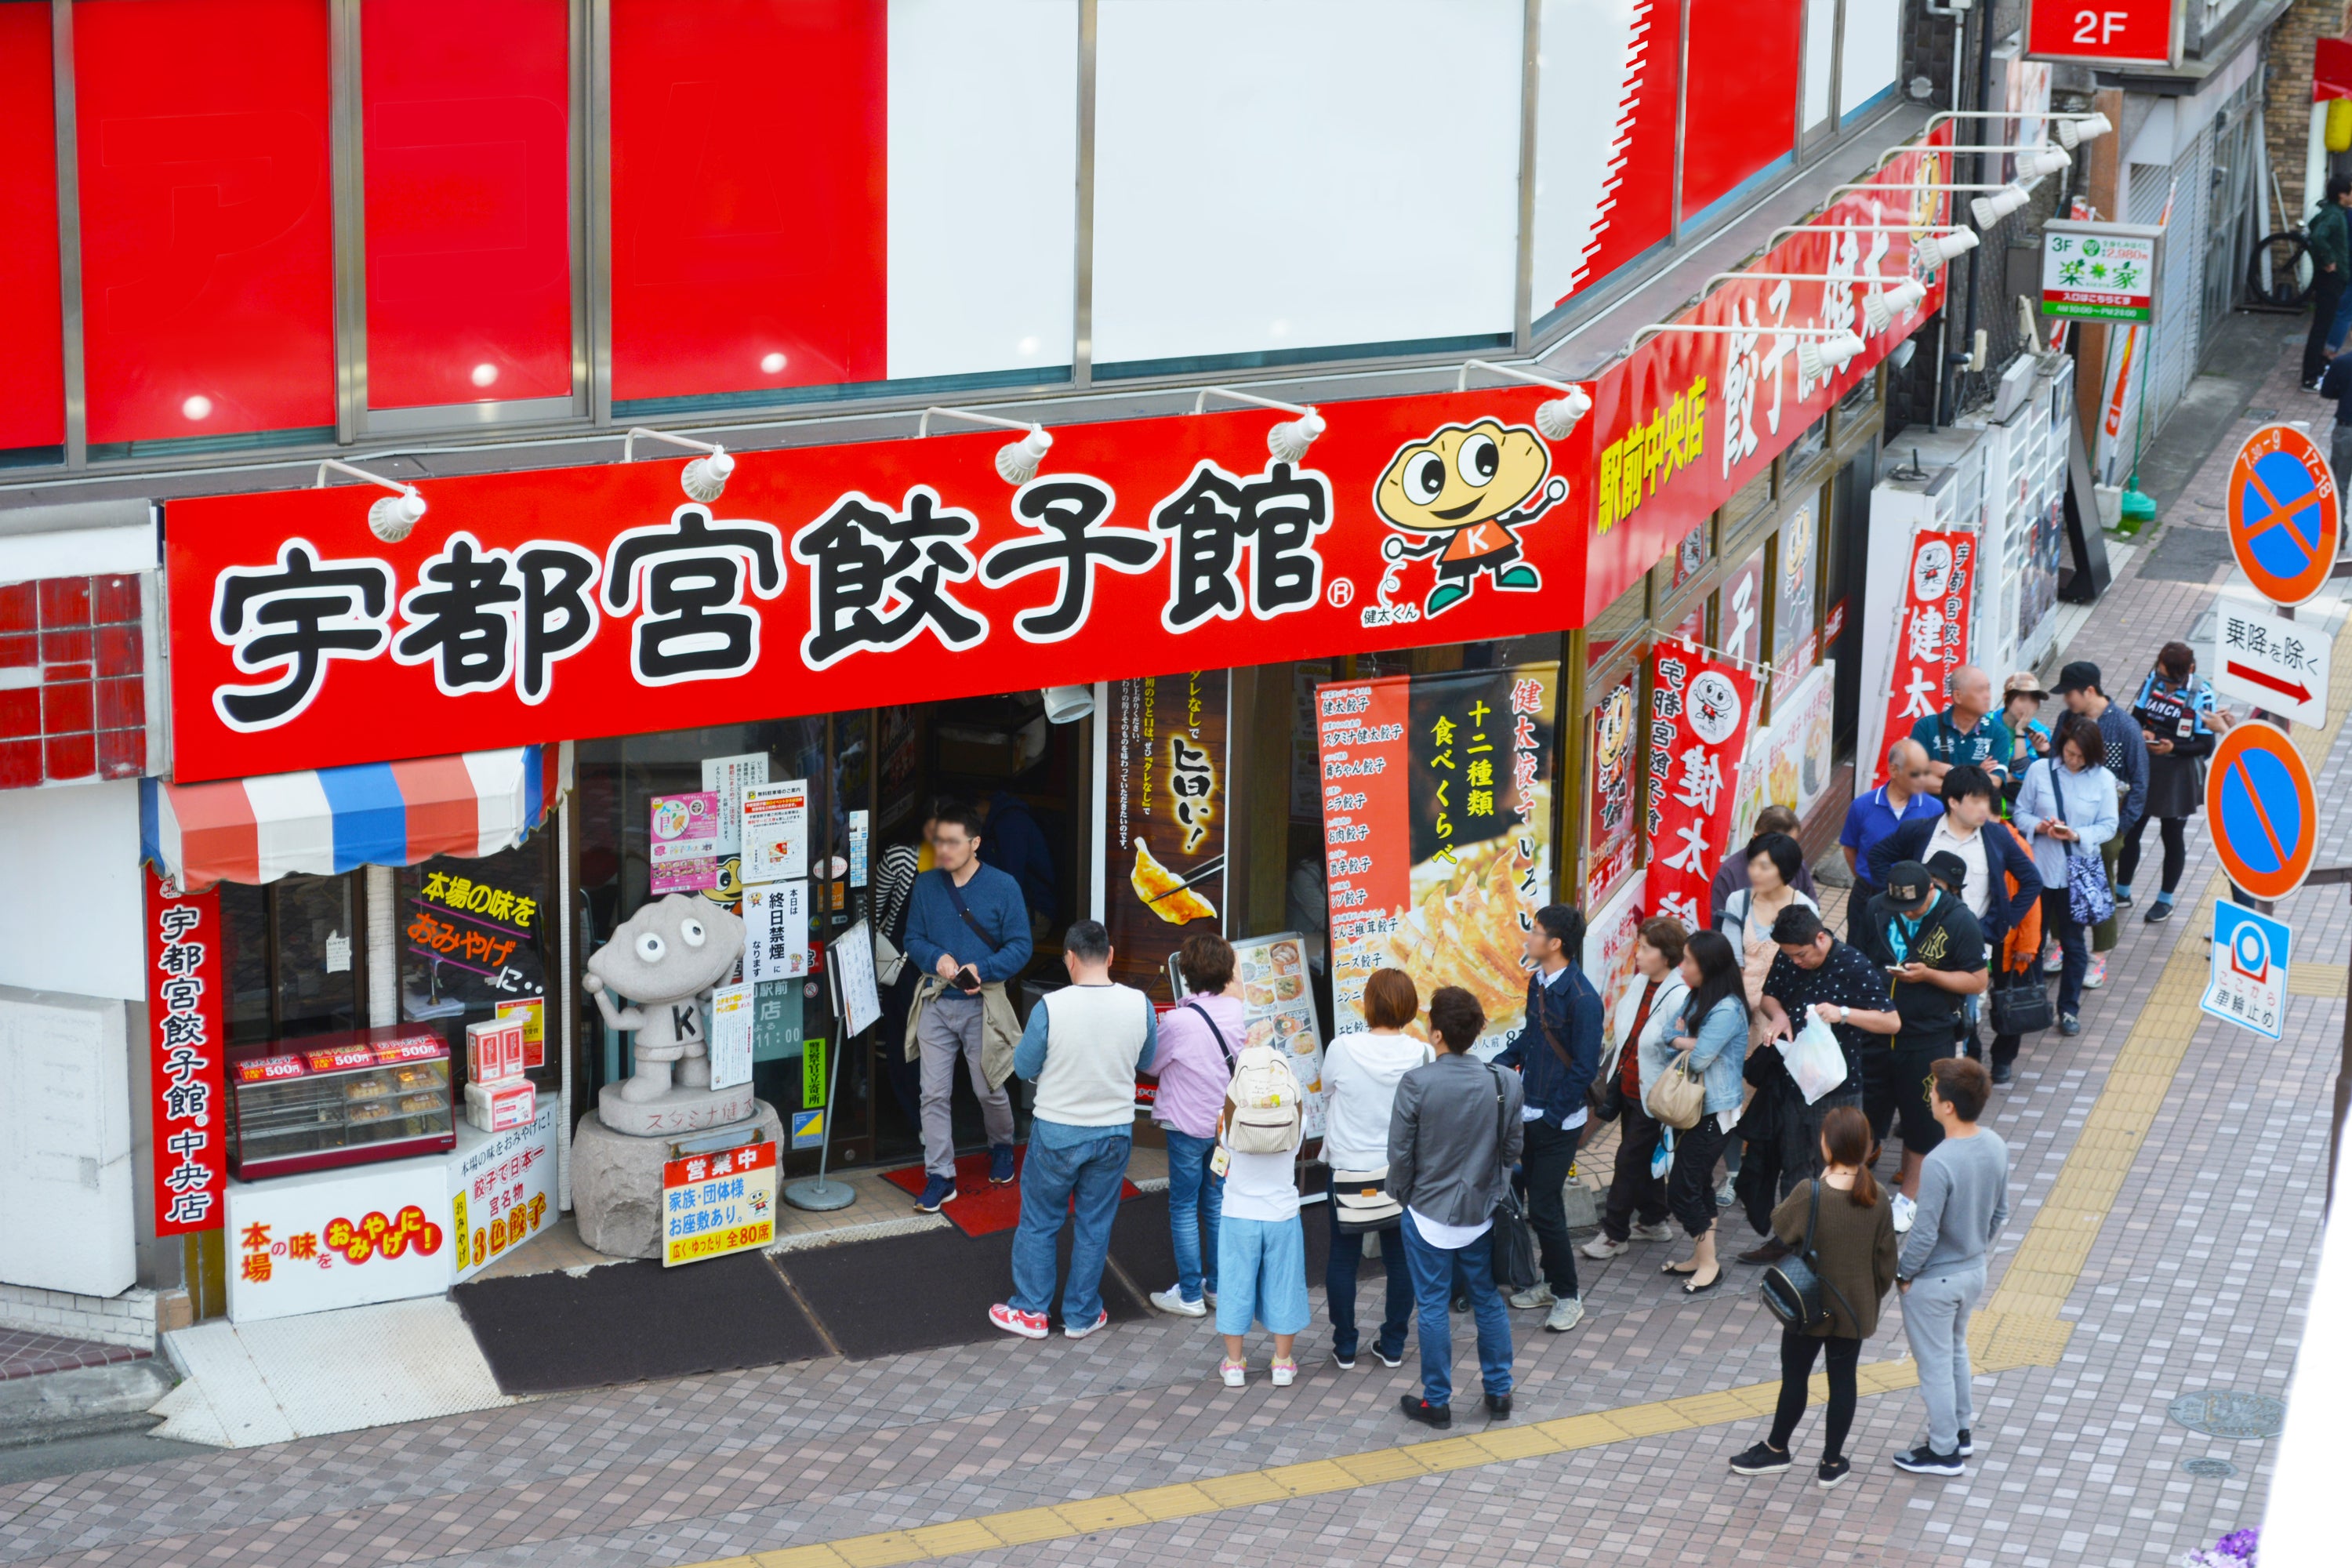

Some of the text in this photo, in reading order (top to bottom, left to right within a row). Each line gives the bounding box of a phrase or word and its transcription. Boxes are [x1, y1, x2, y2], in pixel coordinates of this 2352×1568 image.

[2072, 11, 2127, 45] 2F
[2052, 237, 2074, 252] 3F
[1598, 376, 1707, 535] 駅前中央店
[2301, 445, 2333, 499] 17-18
[1467, 525, 1489, 554] K
[211, 458, 1334, 733] 宇都宮餃子館
[1363, 604, 1418, 626] 健太くん
[1897, 604, 1945, 720] 健太
[2226, 617, 2320, 677] 乗降を除く
[1323, 697, 1370, 715] 健太餃子
[1323, 724, 1403, 746] スタミナ健太餃子
[1466, 700, 1494, 818] 十二種類
[1327, 793, 1367, 811] ニラ餃子
[1430, 715, 1457, 865] 食べくらべ
[1328, 826, 1370, 844] お肉餃子
[422, 871, 536, 927] 本場の味を
[789, 888, 798, 915] 本日は
[1331, 890, 1367, 909] シソ餃子
[407, 913, 517, 967] おみやげ
[1333, 918, 1399, 940] どんこ椎茸餃子
[753, 940, 761, 977] なります
[1335, 953, 1382, 971] チーズ餃子
[1337, 990, 1365, 1003] ニンニ
[2220, 971, 2277, 1007] ここから
[158, 905, 208, 1123] 宇都宮餃子館
[672, 1004, 696, 1041] K
[2214, 989, 2275, 1029] 車輪止め
[335, 1054, 370, 1066] 500円
[401, 1044, 436, 1058] 500円
[265, 1064, 300, 1077] 500円
[808, 1041, 821, 1105] 警察官立寄所
[647, 1098, 754, 1131] スタミナ健太
[472, 1145, 546, 1203] 餃子で日本一
[687, 1149, 757, 1181] 営業中
[490, 1181, 524, 1218] 宮名物
[669, 1178, 744, 1212] 家族・団体様
[456, 1201, 466, 1263] おみやげ
[472, 1191, 547, 1266] 3色餃子
[669, 1206, 742, 1236] お座敷あり。
[727, 1224, 770, 1248] 全80席
